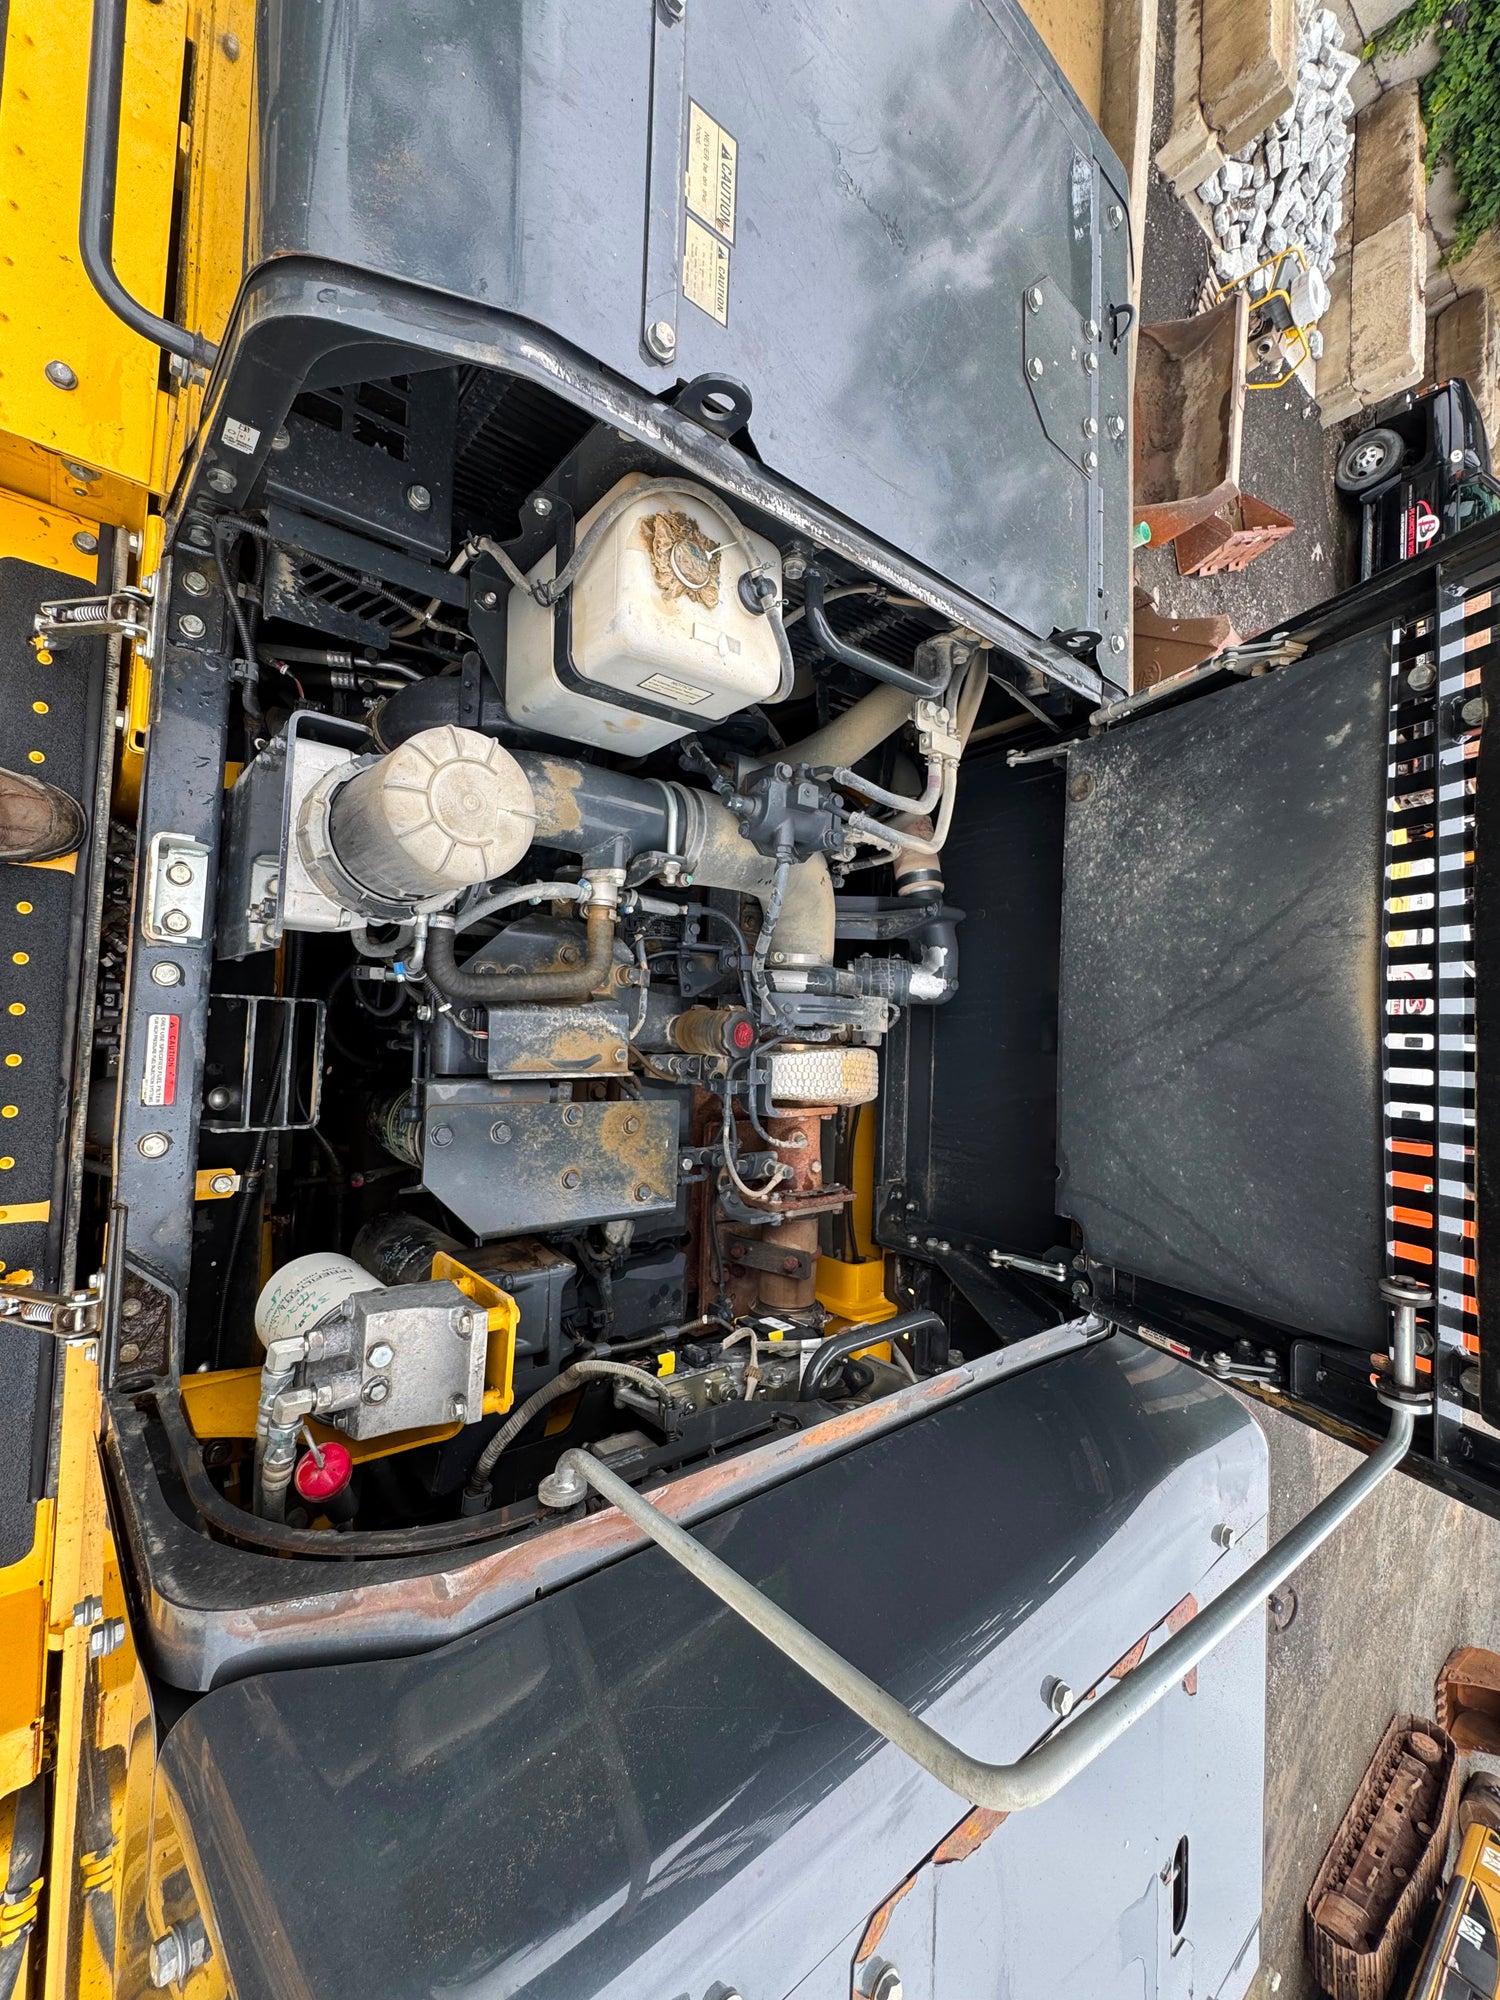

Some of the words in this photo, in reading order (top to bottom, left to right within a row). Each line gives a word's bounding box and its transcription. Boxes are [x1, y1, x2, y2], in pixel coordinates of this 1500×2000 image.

[702, 176, 708, 187] on
[703, 162, 709, 174] be
[720, 162, 732, 226] CAUTION
[716, 266, 726, 314] CAUTION
[168, 1035, 176, 1068] CAUTION
[1480, 1846, 1500, 1878] CAT
[1458, 1914, 1486, 1950] CAT
